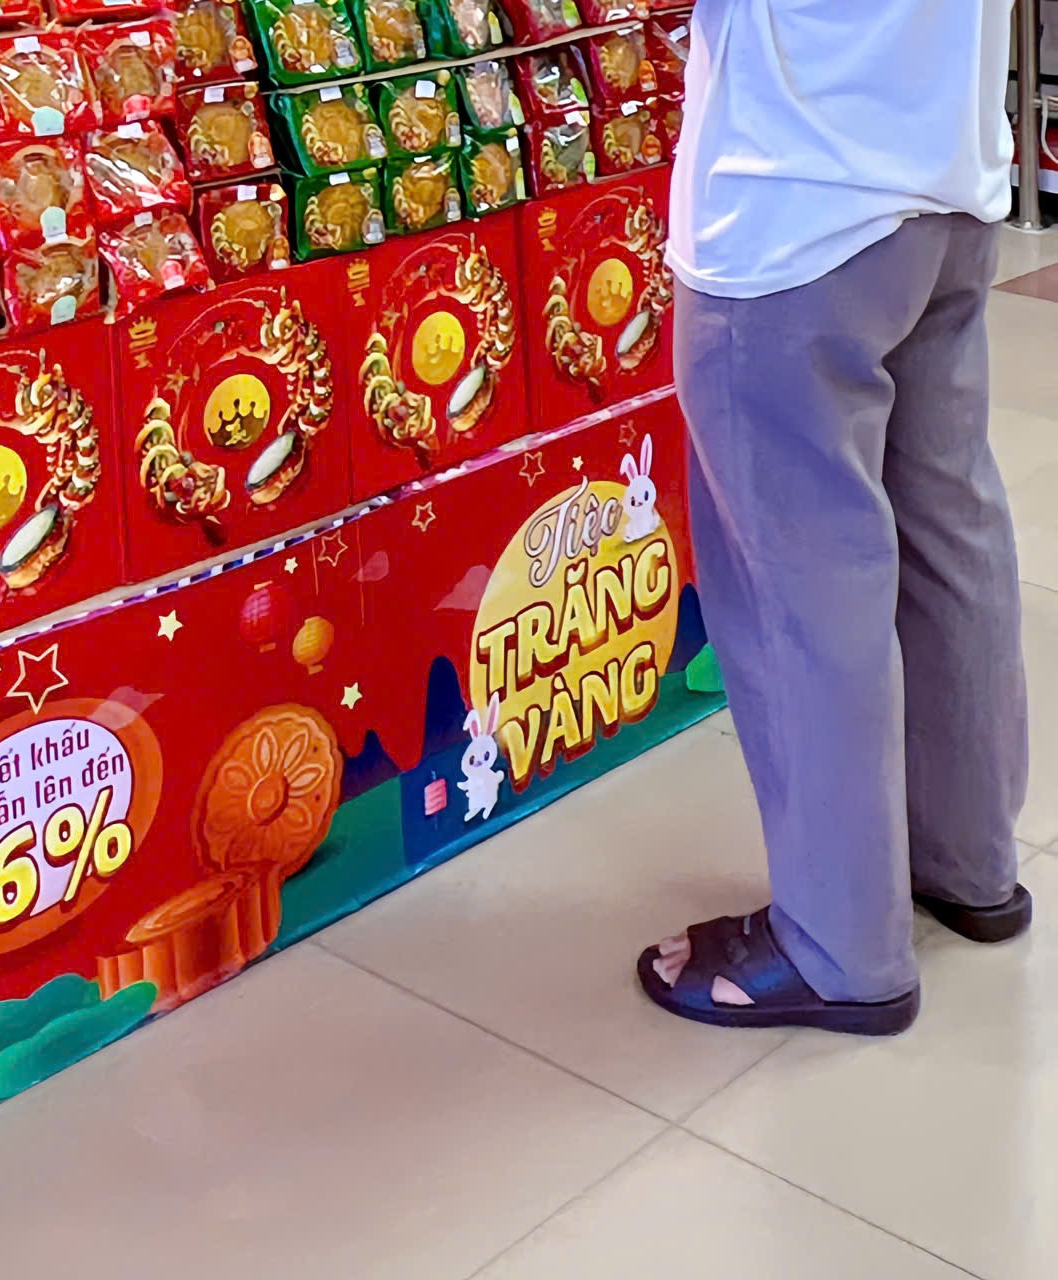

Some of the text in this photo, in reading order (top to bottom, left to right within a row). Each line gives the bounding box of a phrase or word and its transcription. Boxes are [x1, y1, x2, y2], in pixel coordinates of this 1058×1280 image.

[525, 476, 623, 587] Tiệc
[476, 538, 671, 698] TRĂNG
[31, 722, 90, 771] khấu
[501, 641, 659, 792] VÀNG
[35, 775, 73, 808] lên
[81, 747, 124, 788] đến
